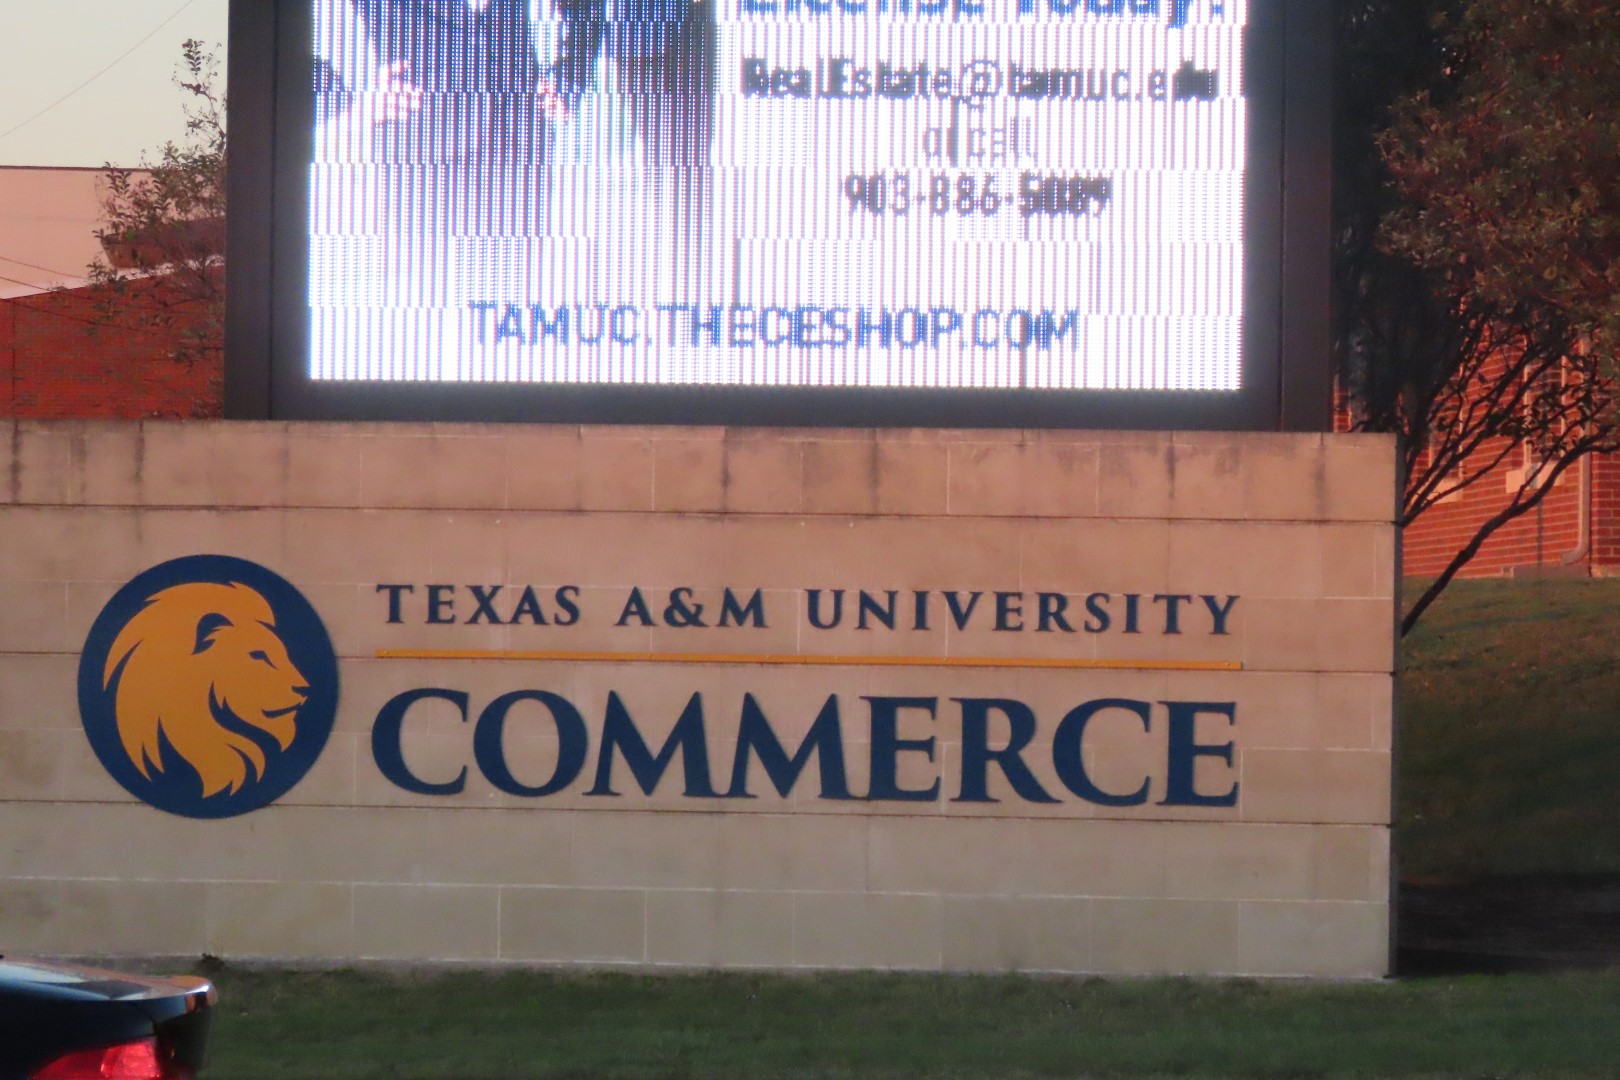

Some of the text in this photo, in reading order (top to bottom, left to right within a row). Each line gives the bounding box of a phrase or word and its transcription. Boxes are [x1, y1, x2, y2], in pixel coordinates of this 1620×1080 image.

[468, 299, 1079, 351] TAMUC.THECESHOP.COM
[376, 583, 1241, 636] TEXAS A&M UNIVERSITY
[371, 687, 1240, 808] COMMERCE
